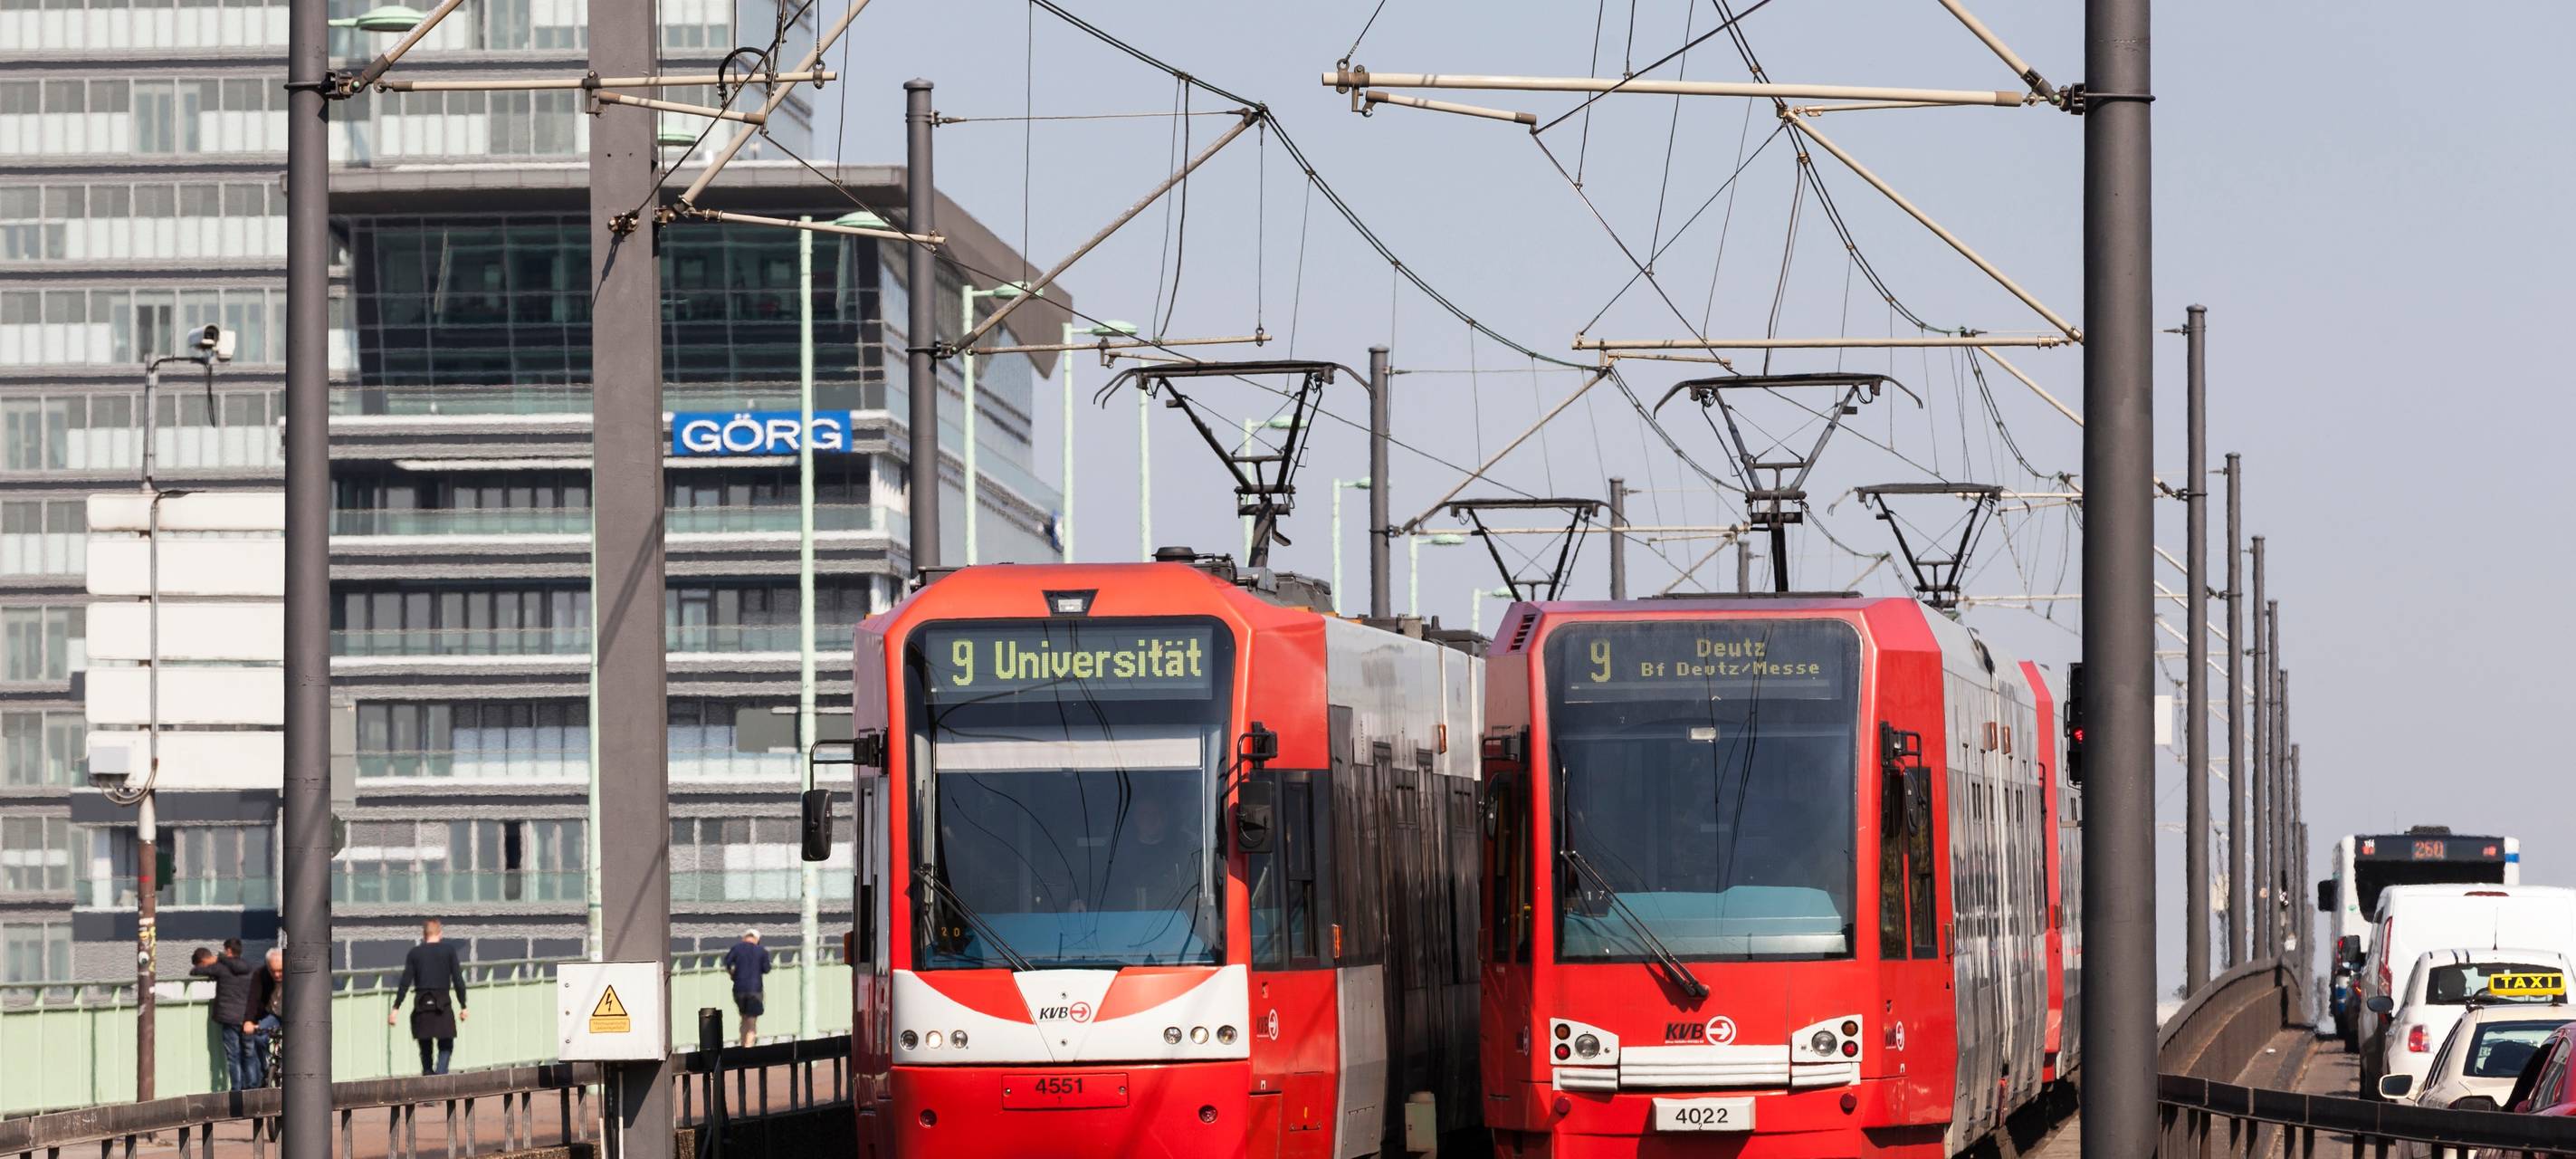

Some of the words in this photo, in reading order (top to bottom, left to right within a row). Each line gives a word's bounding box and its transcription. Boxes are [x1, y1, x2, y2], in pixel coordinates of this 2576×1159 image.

[682, 413, 843, 452] GÖRG
[1696, 637, 1766, 657] Deutz
[952, 638, 973, 686] 9
[995, 638, 1202, 679] Universität
[1590, 638, 1611, 683] 9
[1641, 662, 1666, 677] Bf
[1676, 662, 1820, 676] Deutz/Messe
[2501, 976, 2552, 989] TAXI
[1039, 1007, 1068, 1020] KVB
[1665, 1022, 1704, 1039] KVB
[1035, 1078, 1083, 1094] 4551
[1675, 1107, 1729, 1124] 4022
